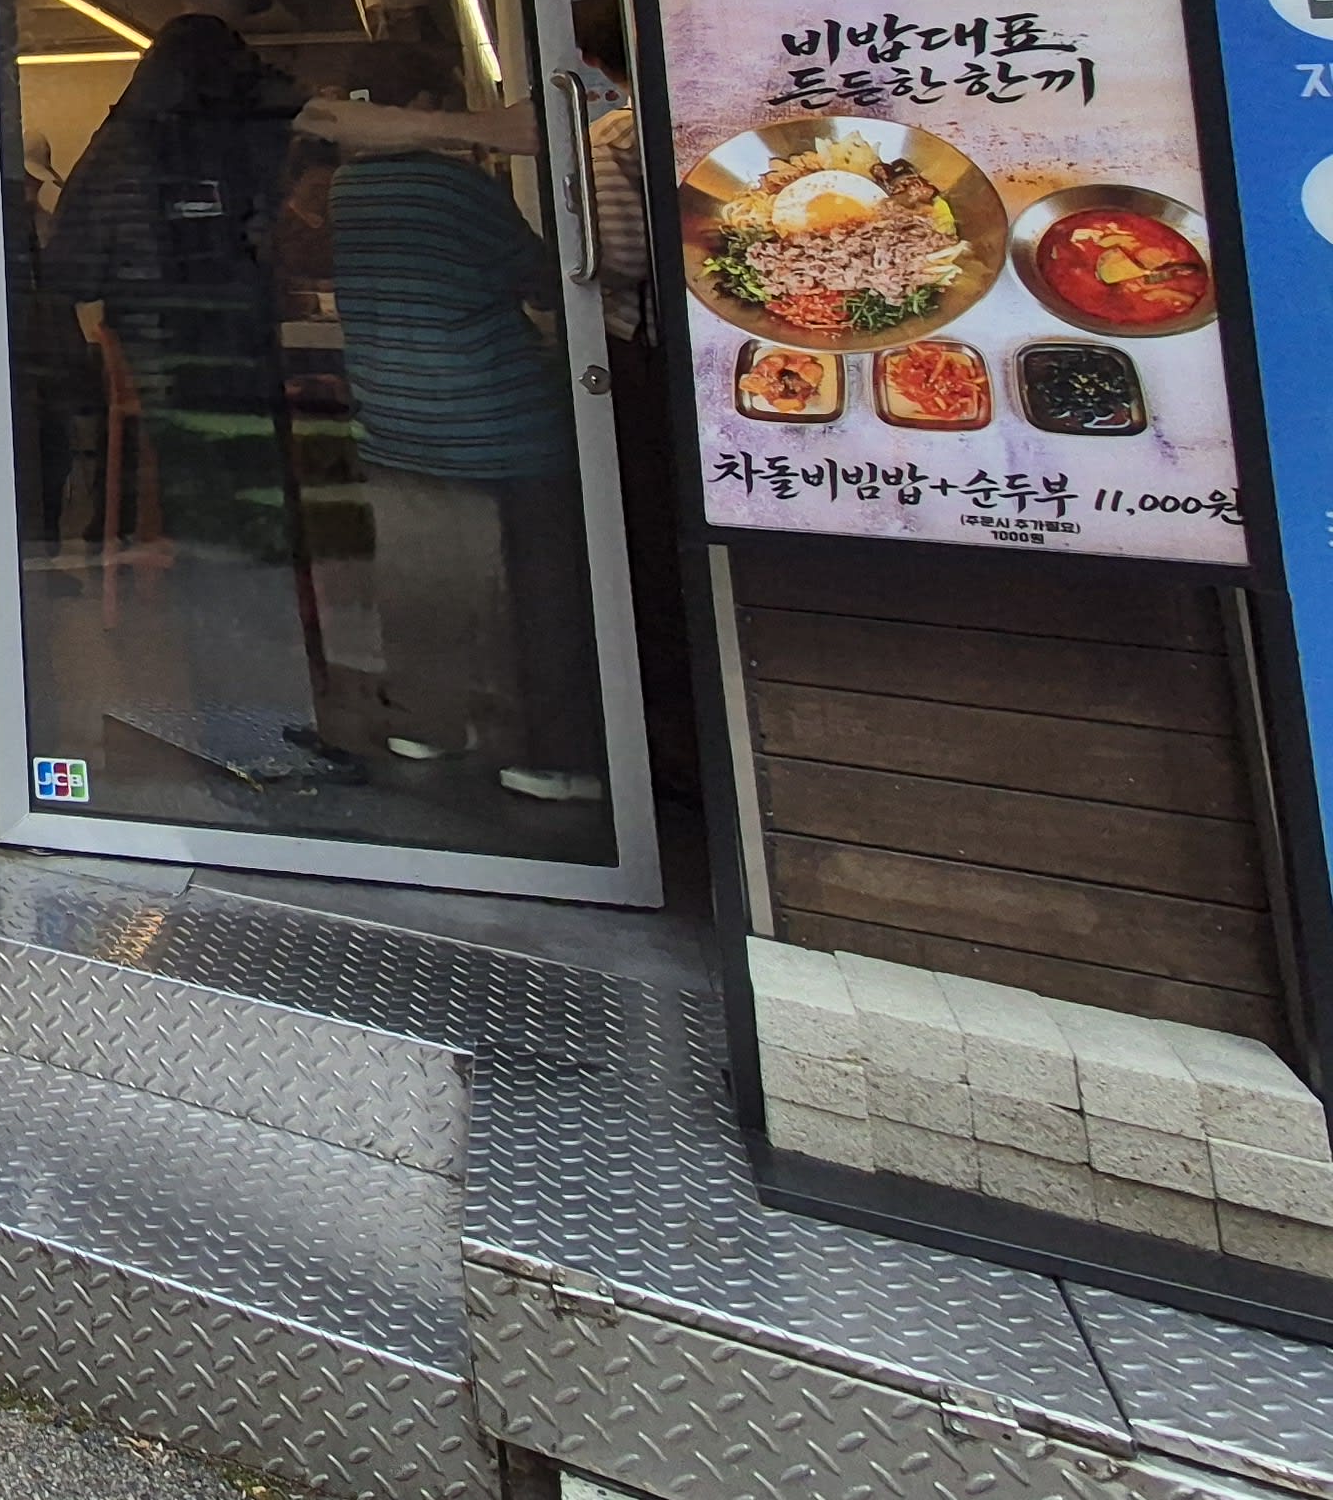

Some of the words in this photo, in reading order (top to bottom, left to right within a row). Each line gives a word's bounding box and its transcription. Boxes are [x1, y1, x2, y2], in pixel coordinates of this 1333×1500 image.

[1094, 486, 1246, 526] 11,000원
[991, 530, 1045, 545] 1000원
[38, 772, 84, 787] JCB
